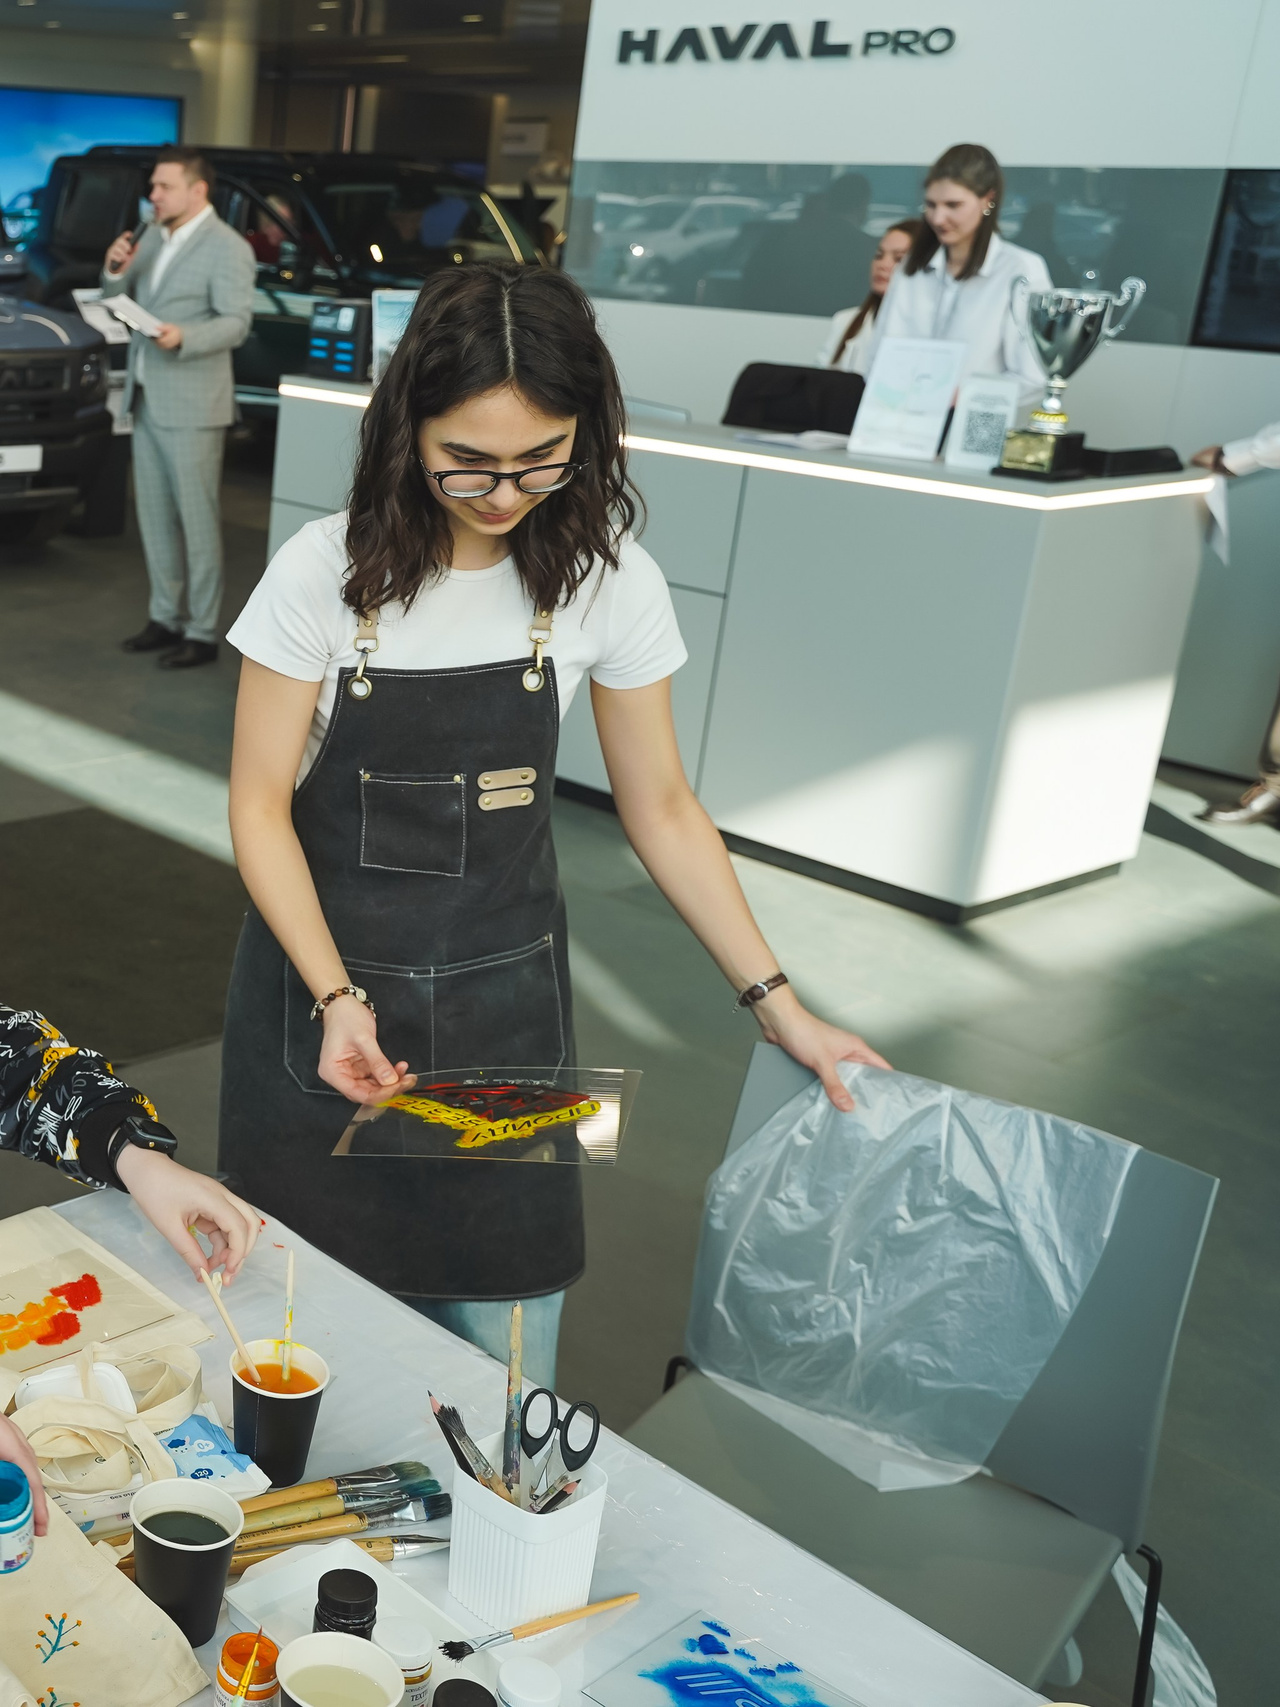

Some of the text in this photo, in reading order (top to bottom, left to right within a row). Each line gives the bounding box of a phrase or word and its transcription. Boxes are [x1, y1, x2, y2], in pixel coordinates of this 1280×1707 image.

[617, 20, 957, 63] HAVAL PRO
[194, 1469, 211, 1478] 120
